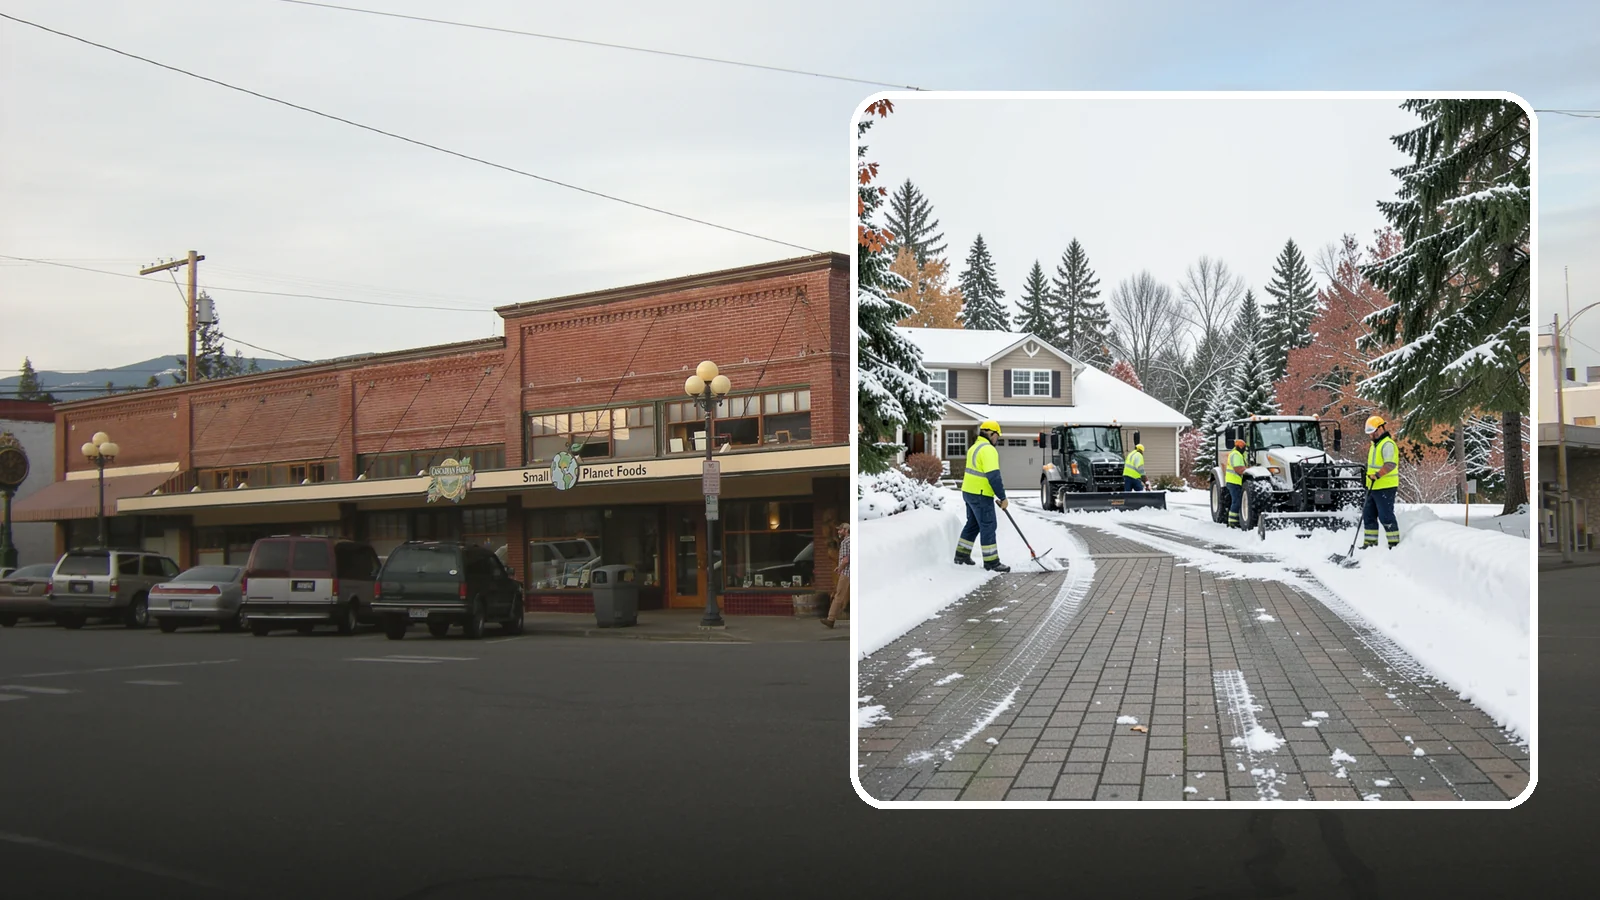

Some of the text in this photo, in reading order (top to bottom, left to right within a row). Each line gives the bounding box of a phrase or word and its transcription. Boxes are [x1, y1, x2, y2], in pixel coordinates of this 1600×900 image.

[523, 464, 647, 483] Small Planet Foods
